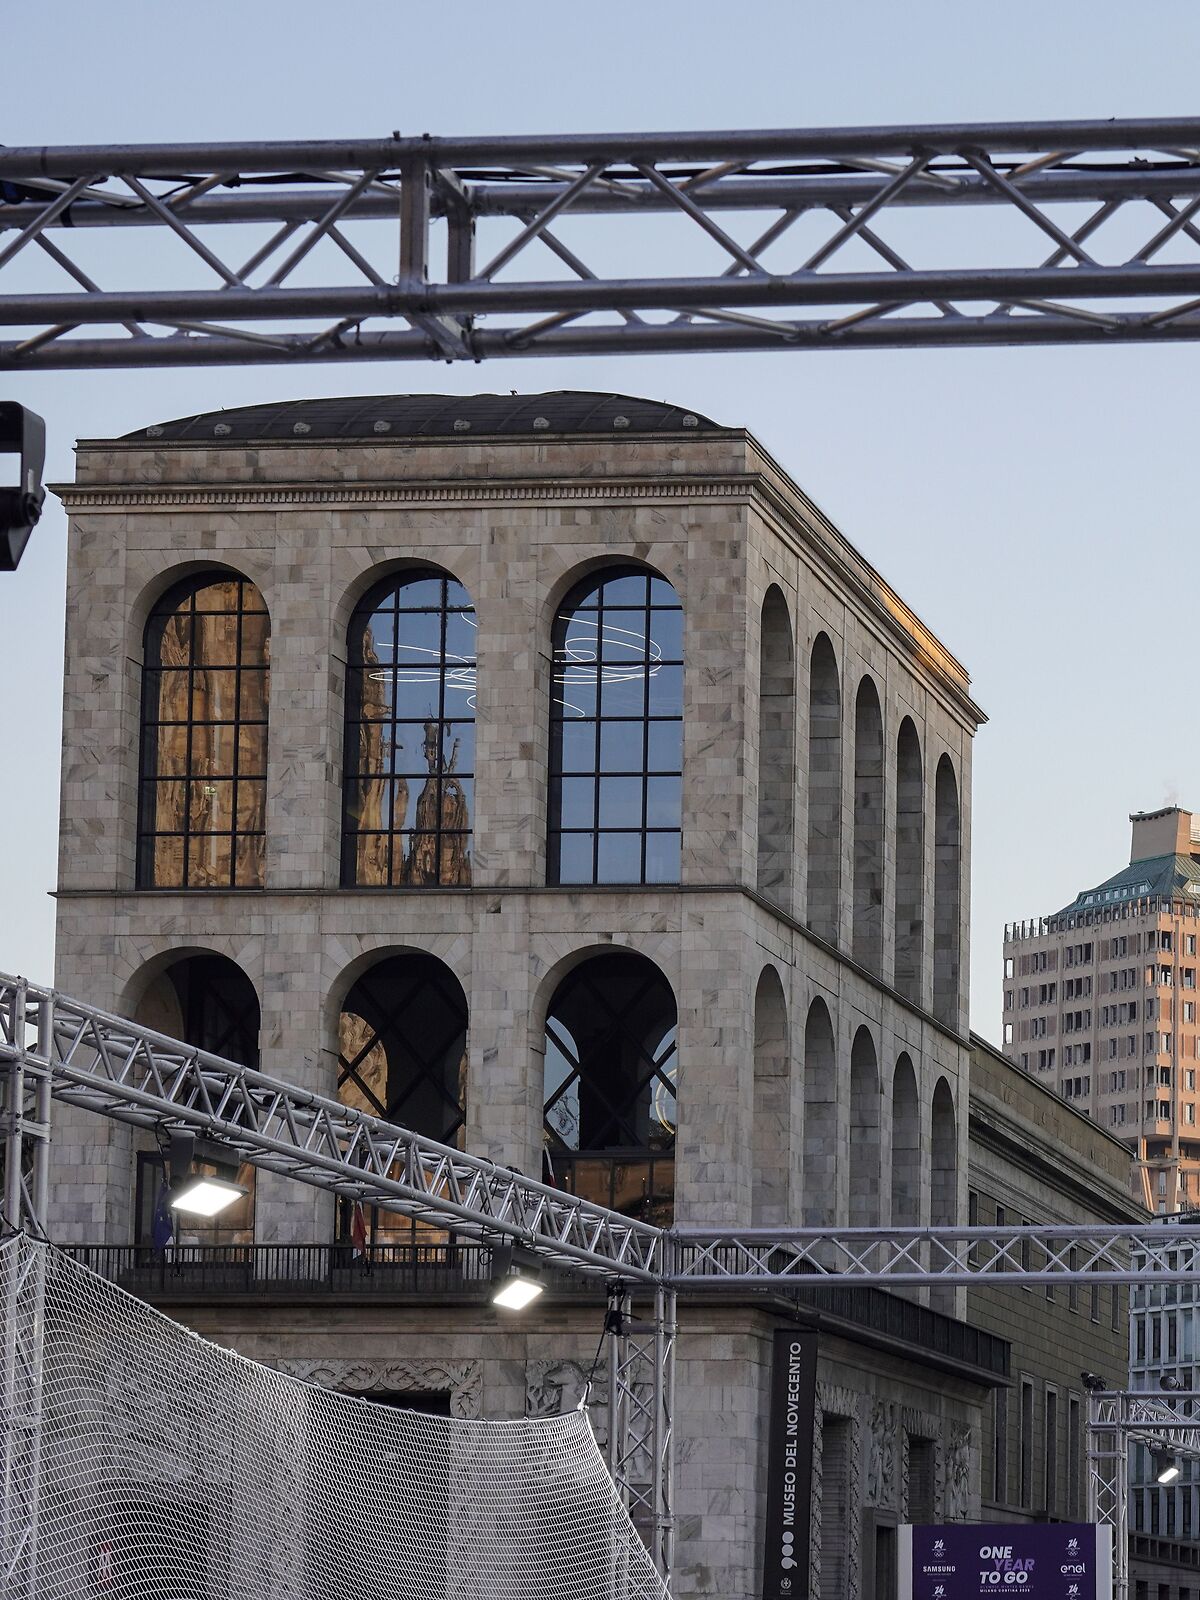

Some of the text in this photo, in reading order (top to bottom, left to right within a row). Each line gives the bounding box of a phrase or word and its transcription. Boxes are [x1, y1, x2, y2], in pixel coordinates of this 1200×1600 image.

[787, 1342, 802, 1436] NOVECENTO
[785, 1440, 797, 1468] DEL
[783, 1472, 796, 1526] MUSEO
[979, 1546, 1013, 1559] ONE
[922, 1565, 956, 1573] SAMSUNG
[994, 1558, 1035, 1571] YEAR
[1060, 1562, 1086, 1574] enel
[979, 1571, 1029, 1584] TO GO
